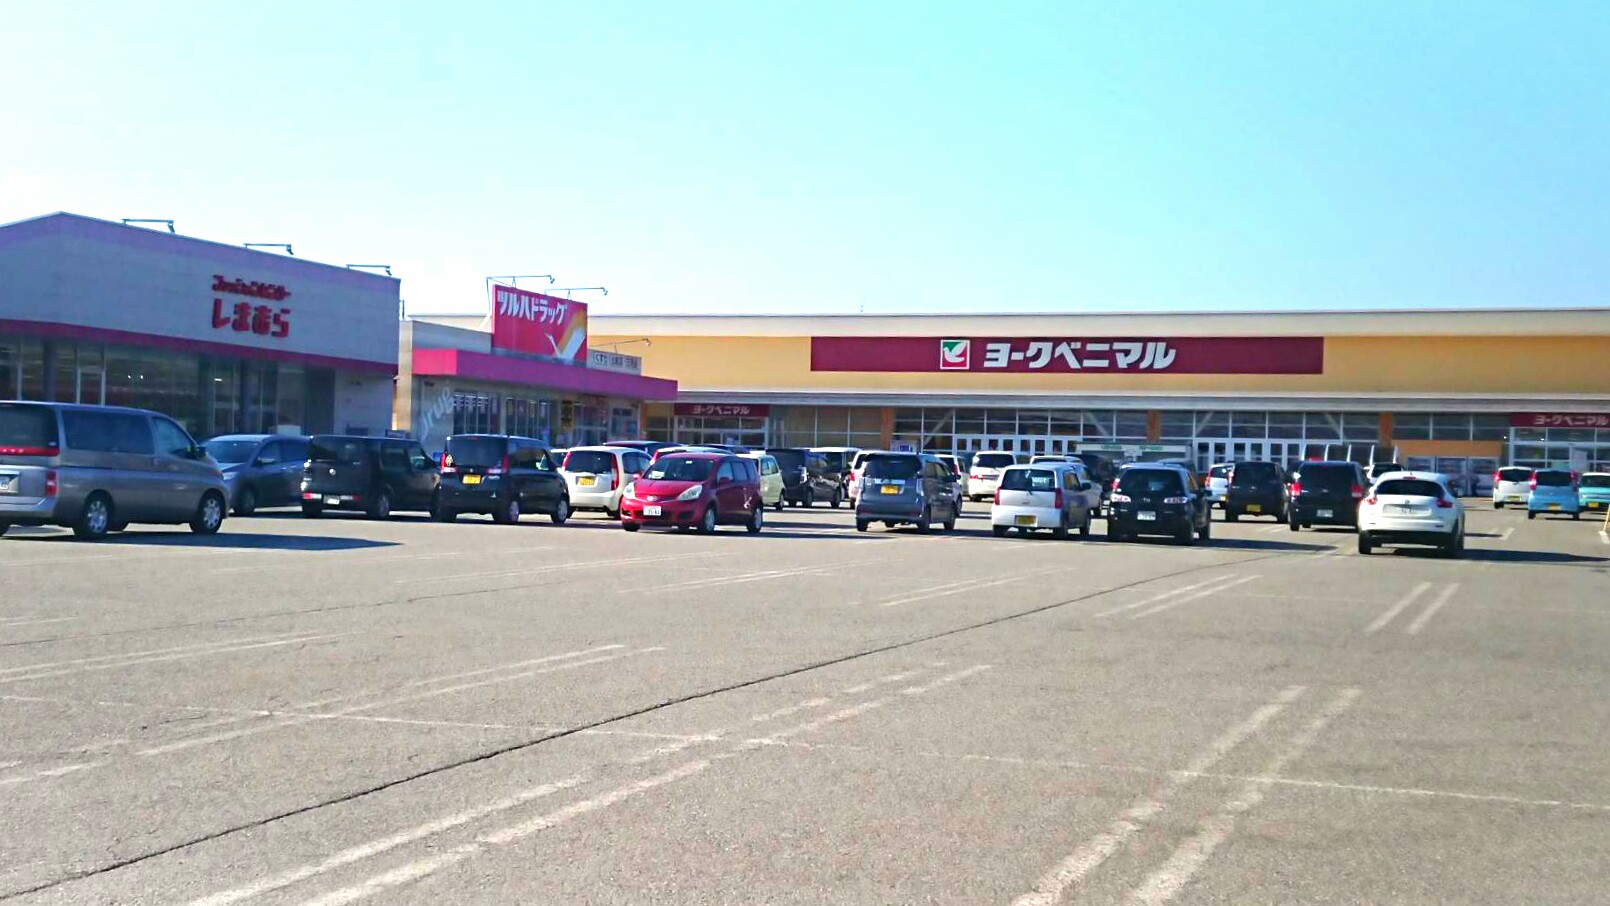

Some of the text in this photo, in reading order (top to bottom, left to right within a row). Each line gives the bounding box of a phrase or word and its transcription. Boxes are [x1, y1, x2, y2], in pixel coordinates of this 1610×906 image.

[212, 298, 291, 338] しまむら
[497, 290, 568, 326] ツルハドラッグ
[983, 341, 1177, 369] ヨークベニマル
[692, 404, 751, 415] ヨークベニマル
[1534, 414, 1609, 426] ヨークベニマル
